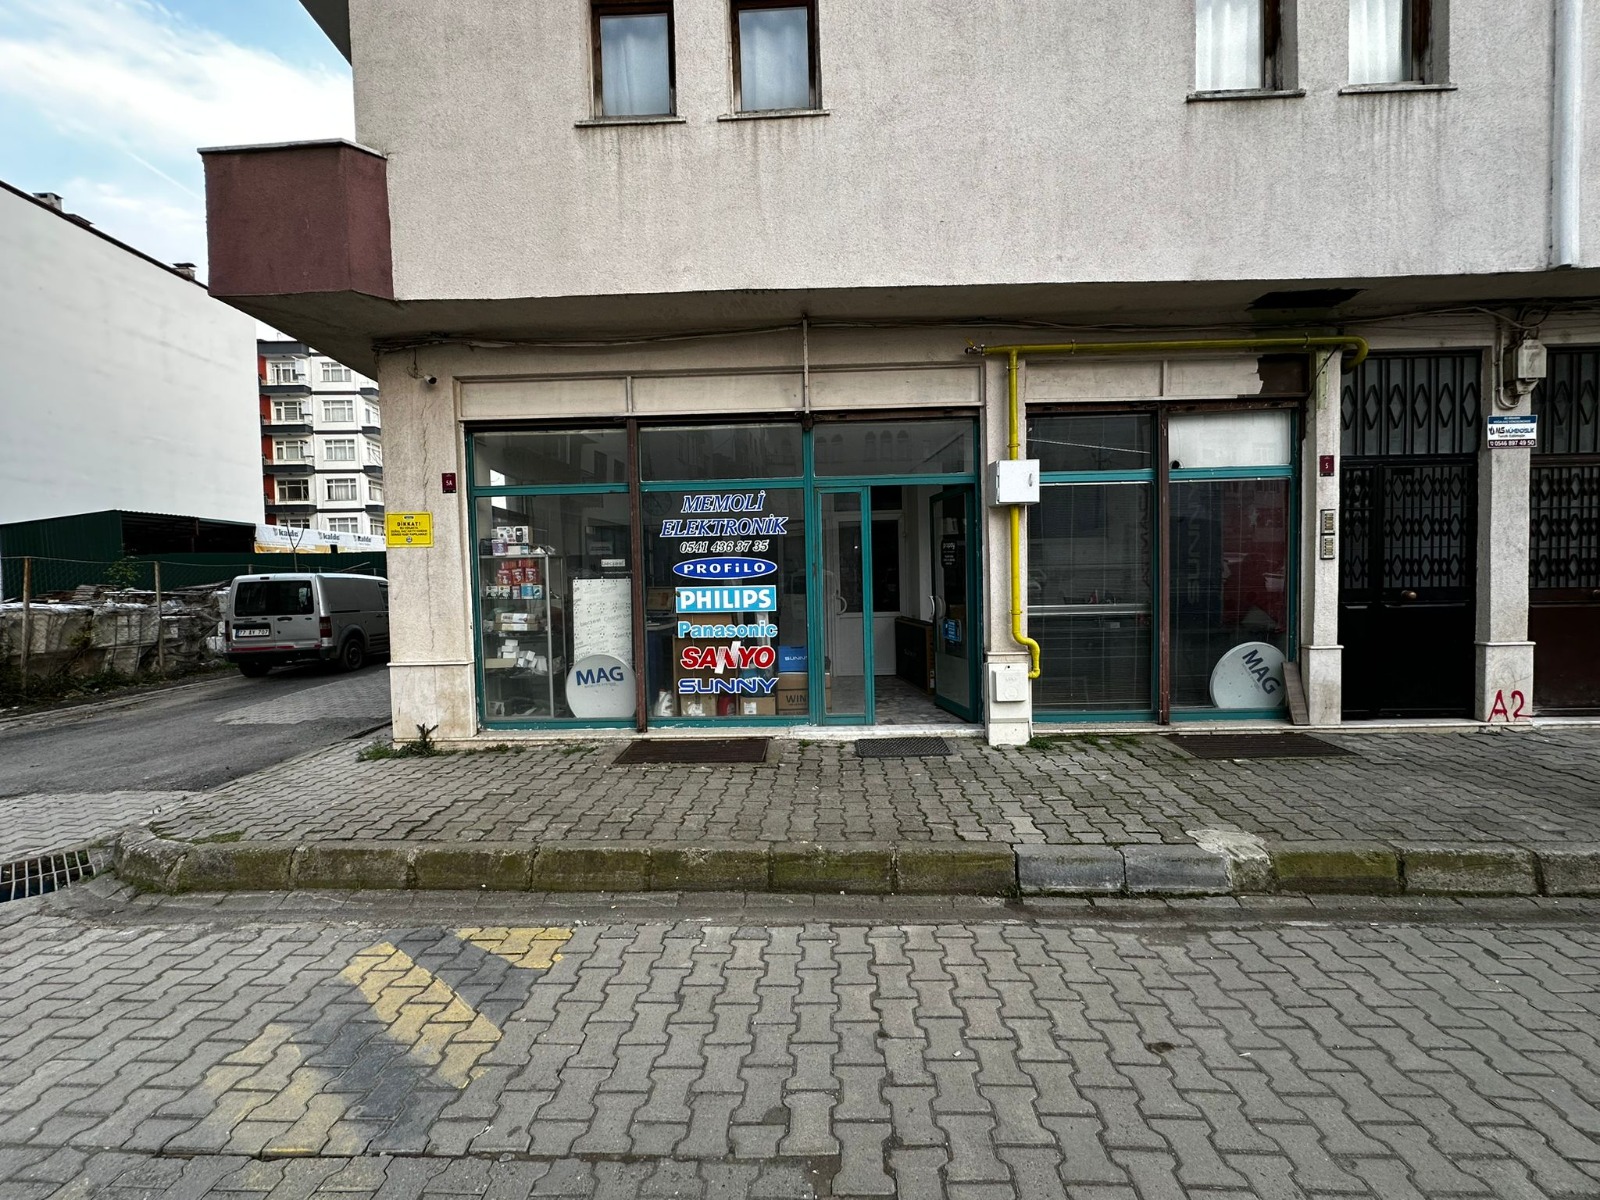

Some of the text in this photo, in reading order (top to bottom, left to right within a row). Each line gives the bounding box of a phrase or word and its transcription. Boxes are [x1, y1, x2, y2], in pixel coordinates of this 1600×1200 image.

[681, 490, 766, 513] MEMOLİ
[660, 514, 789, 538] ELEKTRONİK
[680, 539, 769, 553] 0541 436 37 35
[680, 589, 772, 609] PHILIPS
[677, 620, 778, 638] Panasonic
[680, 641, 776, 674] SANYO
[576, 666, 625, 686] MAG
[1242, 649, 1281, 694] MAG
[678, 677, 779, 694] SUNNY
[1488, 690, 1532, 722] A2
